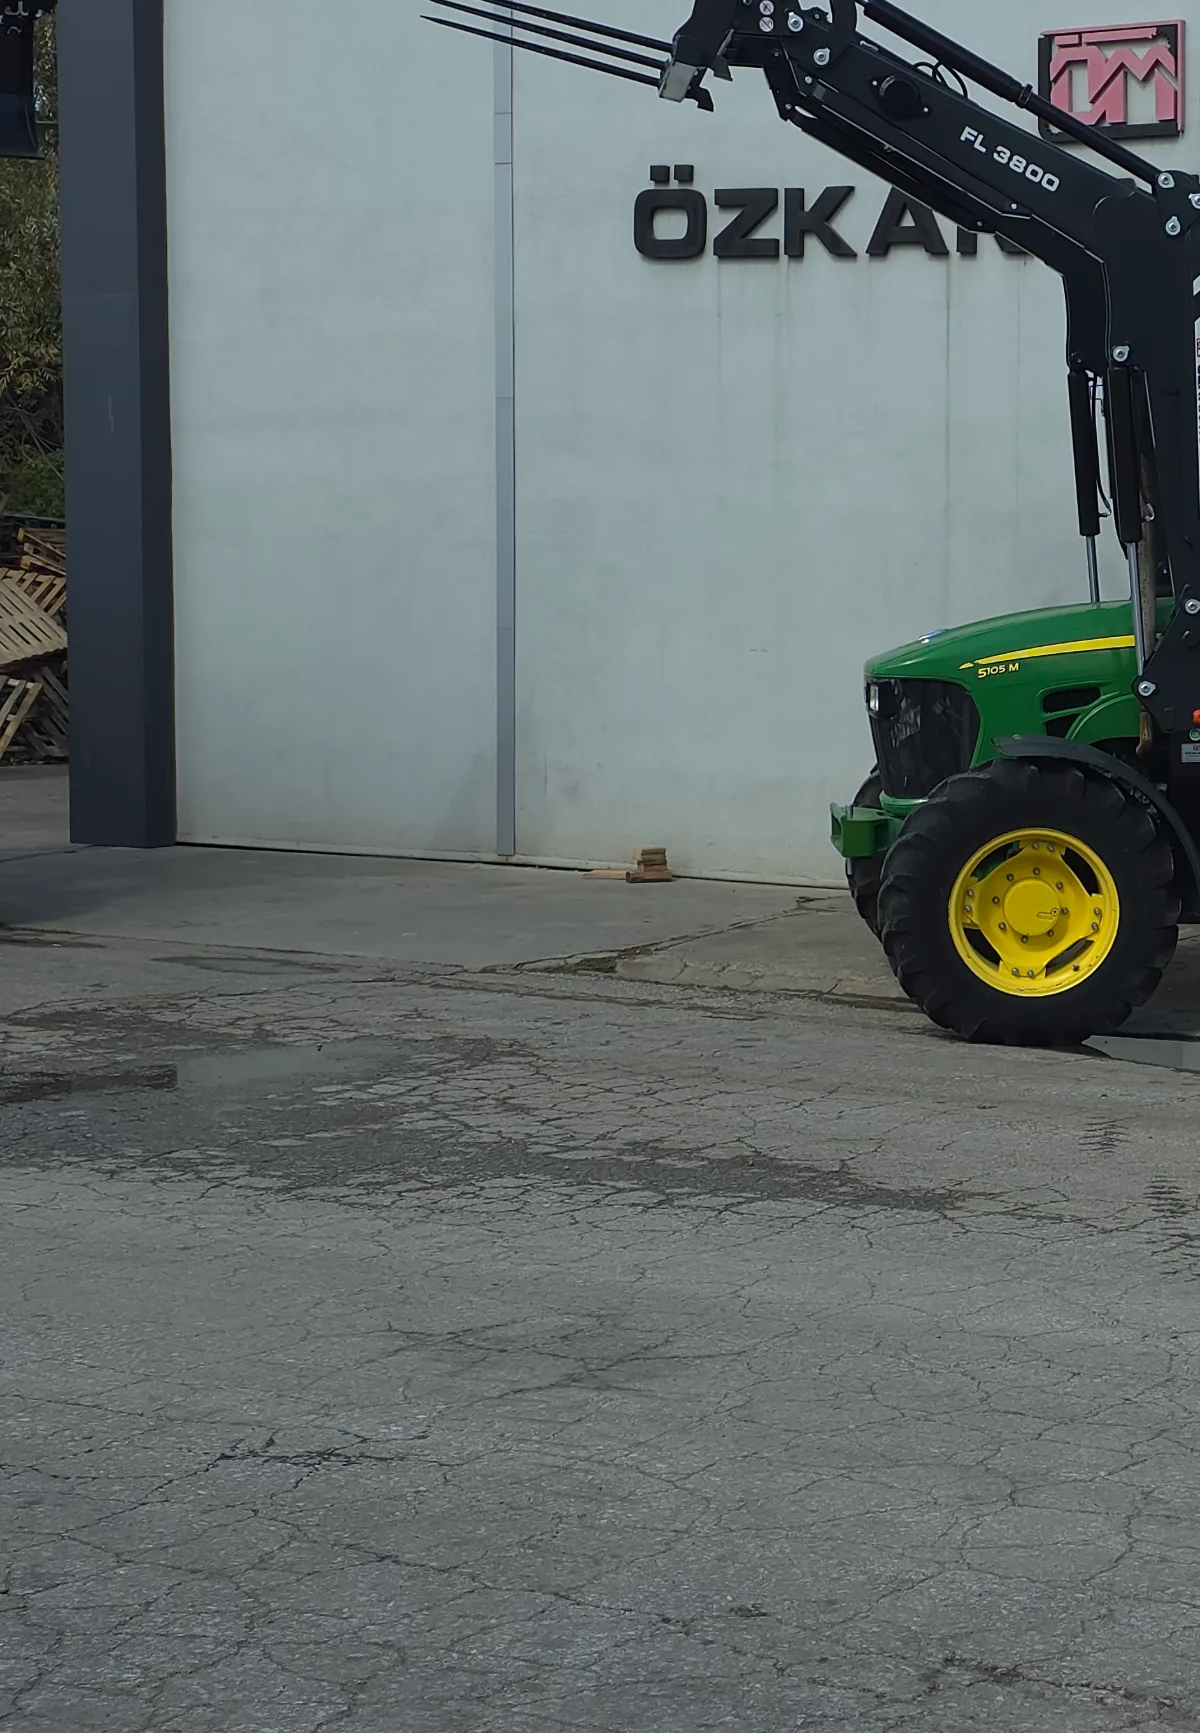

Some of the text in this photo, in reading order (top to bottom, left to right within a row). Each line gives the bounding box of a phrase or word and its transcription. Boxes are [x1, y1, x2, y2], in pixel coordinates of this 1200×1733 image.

[960, 126, 1060, 192] FL 3800
[633, 165, 1034, 259] ÖZKA
[977, 662, 1019, 679] 5105 M
